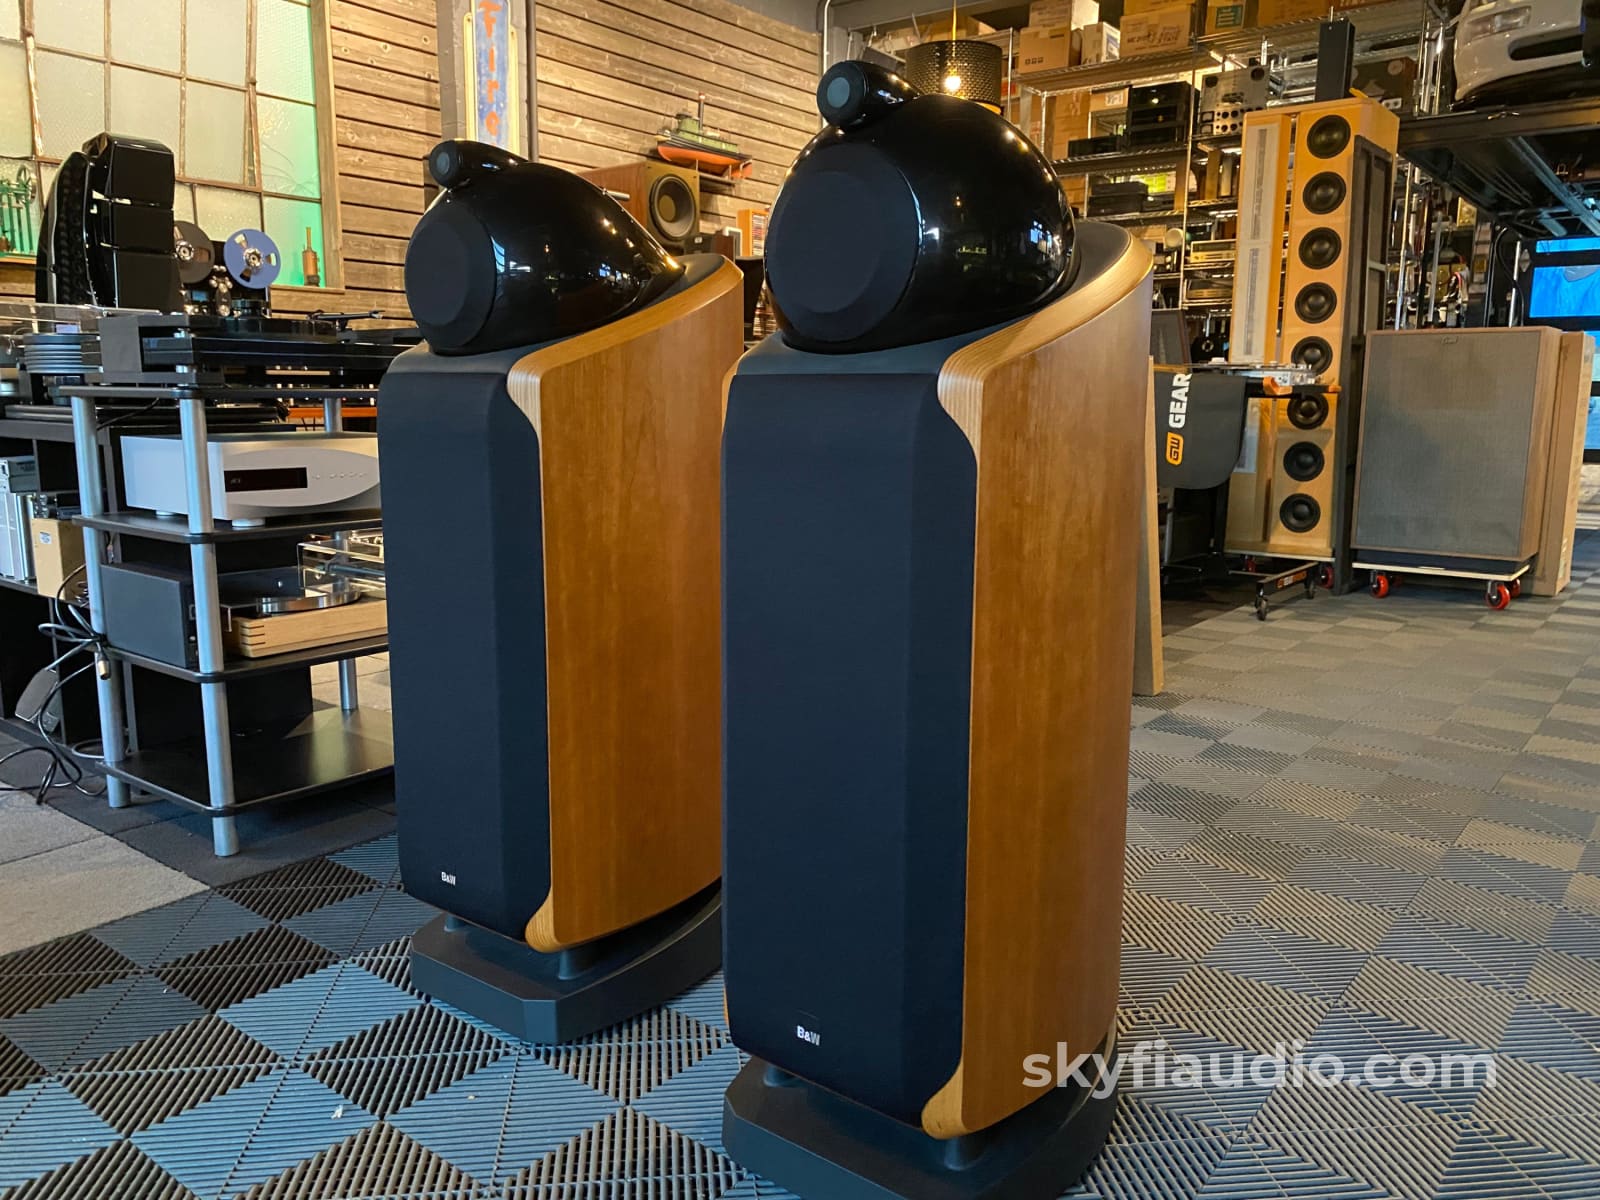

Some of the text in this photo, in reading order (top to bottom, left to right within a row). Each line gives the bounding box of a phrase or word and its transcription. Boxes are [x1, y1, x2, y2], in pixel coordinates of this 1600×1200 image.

[478, 0, 503, 147] Fire
[1168, 373, 1193, 429] GEAR
[797, 1025, 820, 1046] B&W
